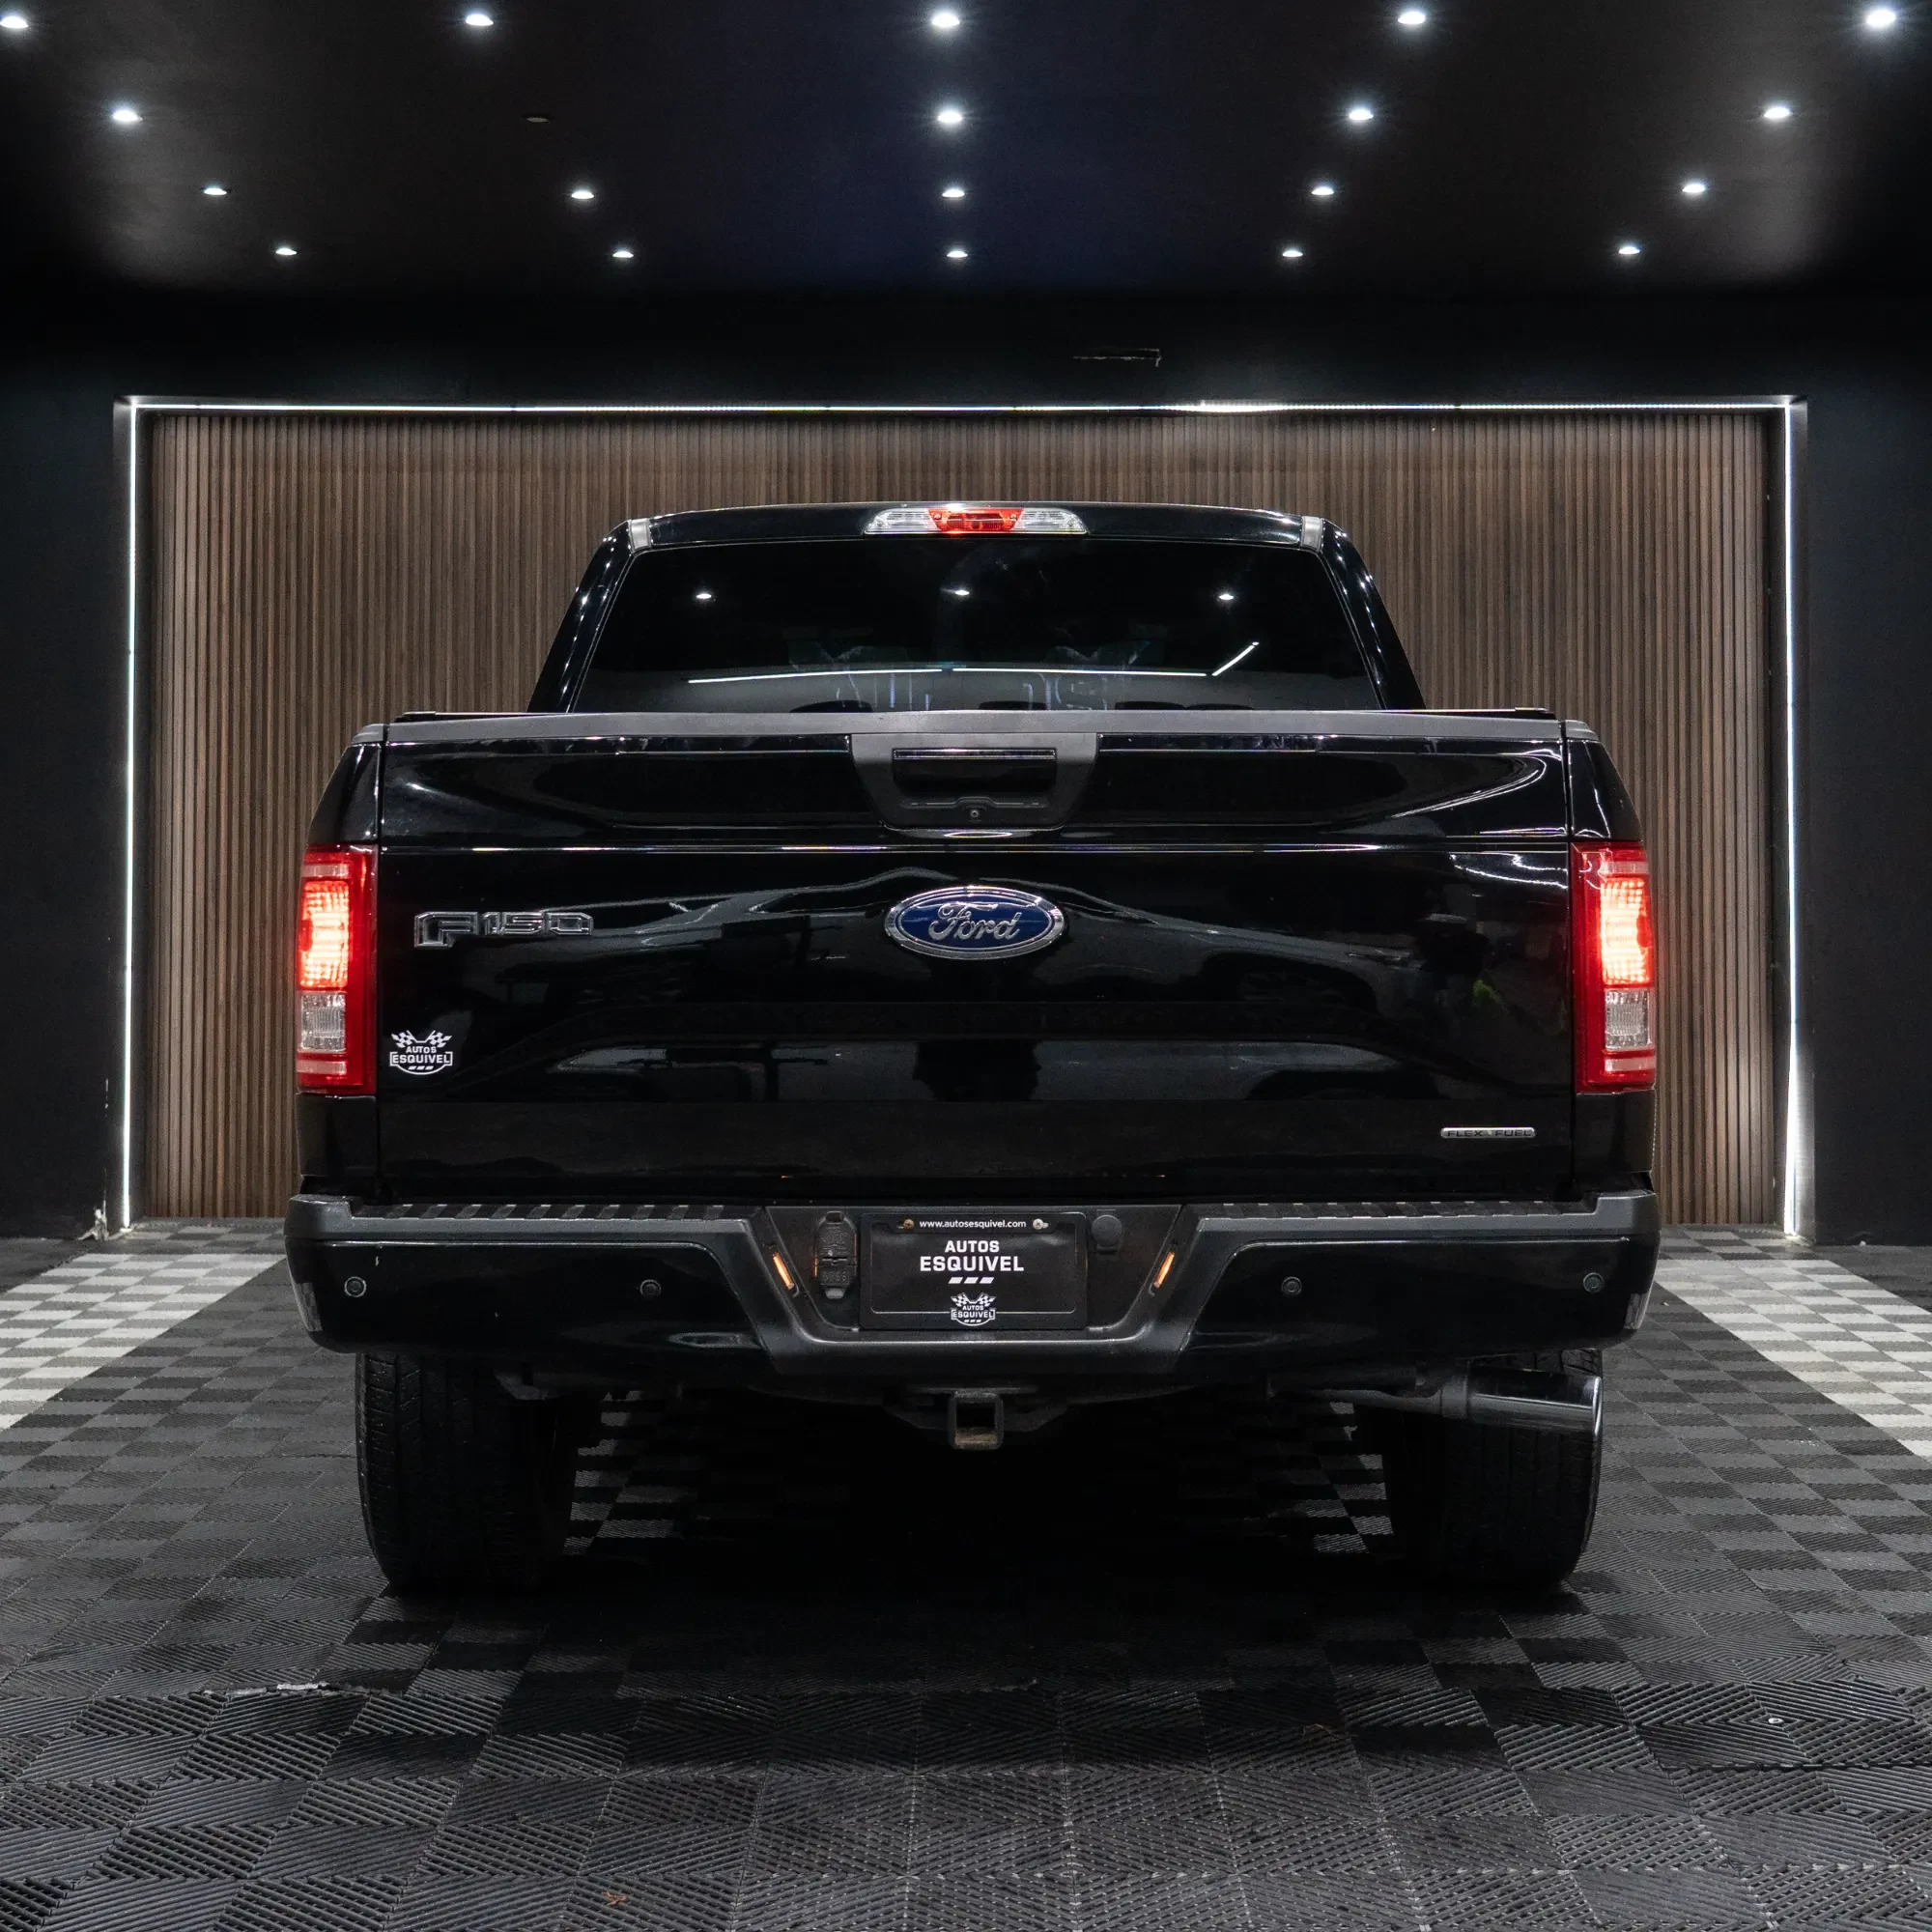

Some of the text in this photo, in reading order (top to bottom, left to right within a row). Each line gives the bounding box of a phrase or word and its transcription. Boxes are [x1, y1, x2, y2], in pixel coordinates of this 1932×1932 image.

[928, 900, 1023, 941] Ford
[392, 1055, 450, 1064] ESQUIVEL
[919, 1219, 1027, 1229] www.autosesquivel.com
[944, 1240, 1000, 1253] AUTOS
[920, 1256, 1024, 1272] ESQUIVEL
